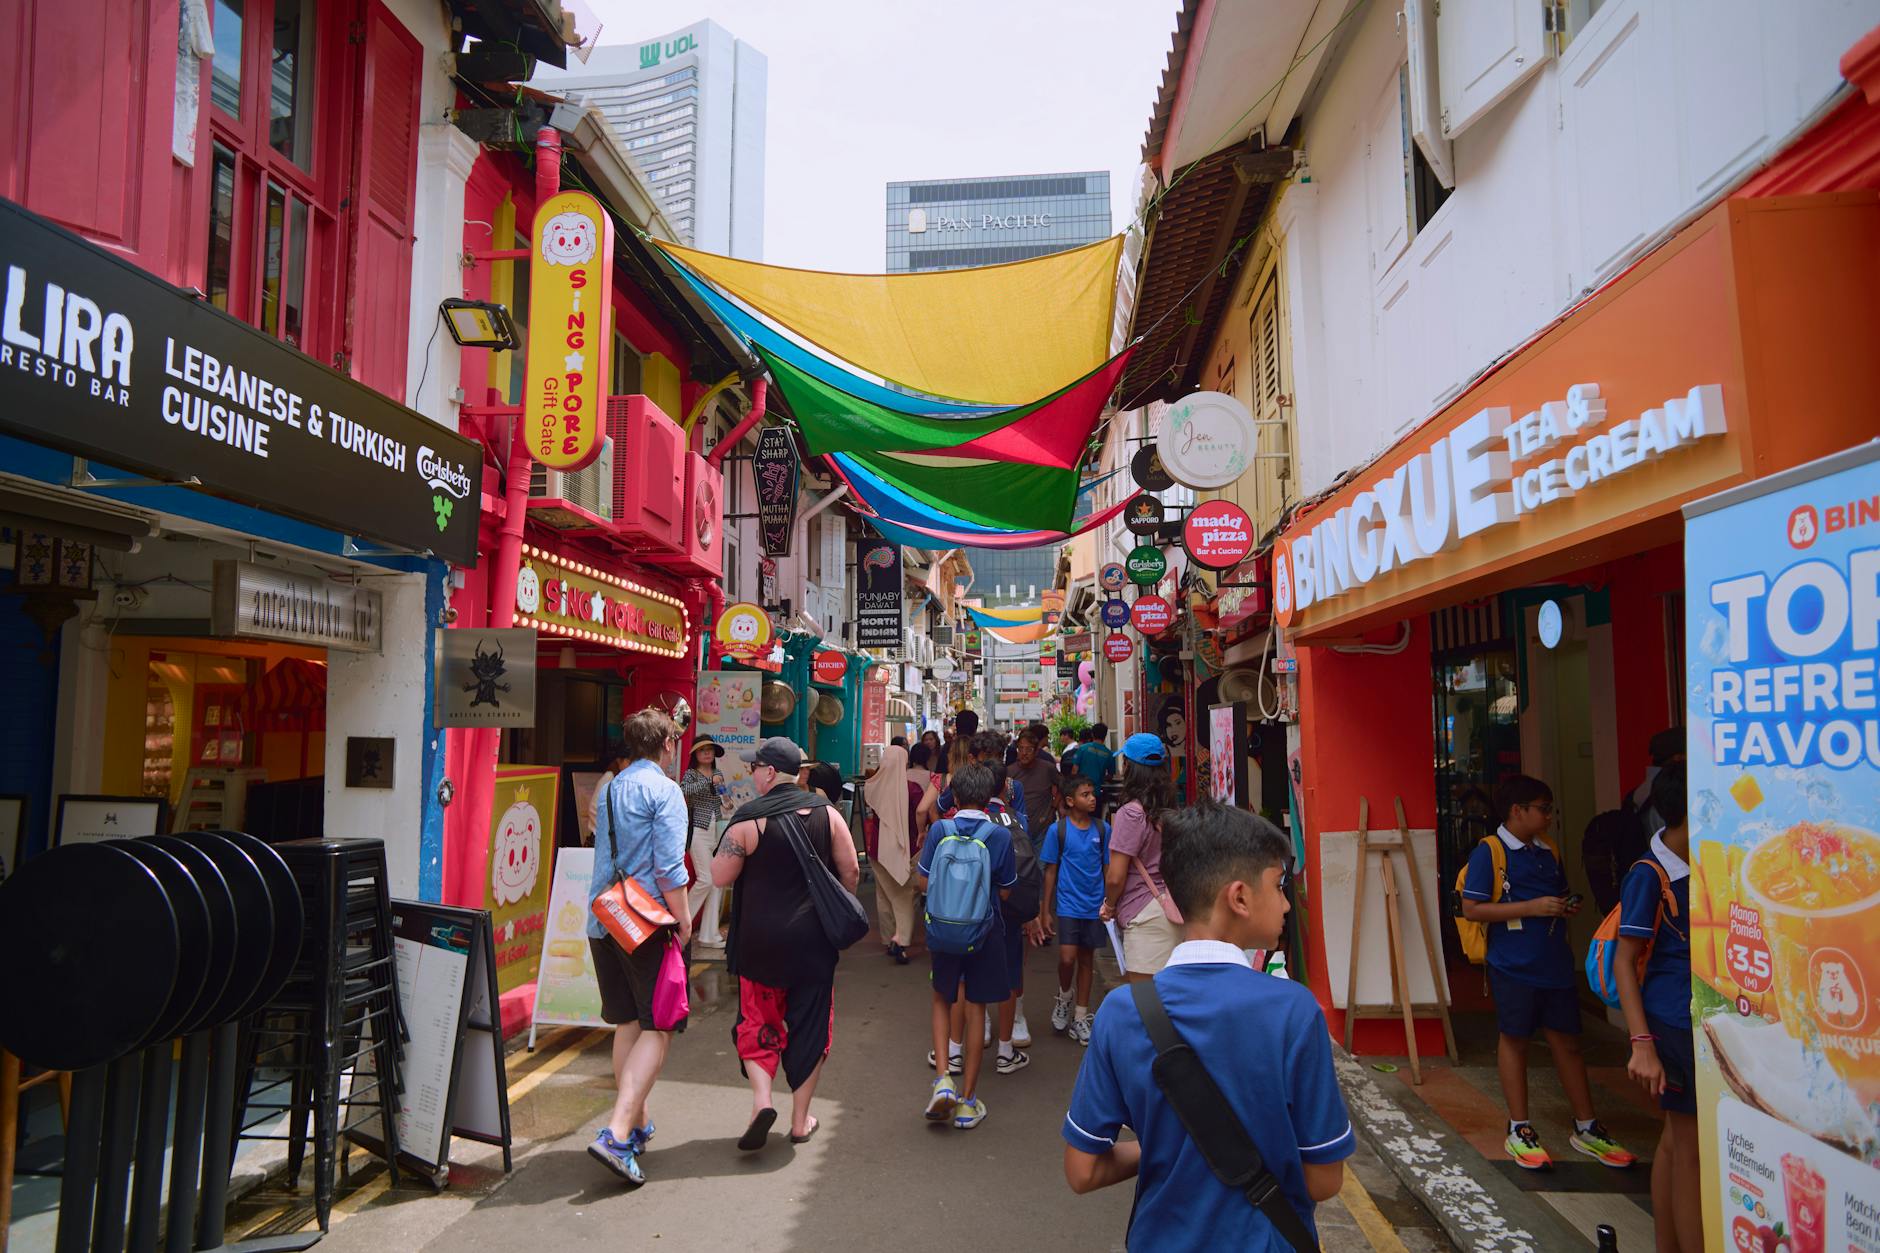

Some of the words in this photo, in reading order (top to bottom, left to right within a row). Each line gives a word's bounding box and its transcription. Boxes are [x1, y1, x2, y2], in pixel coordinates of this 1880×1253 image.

[666, 33, 698, 59] UOL
[936, 216, 972, 232] PAN
[982, 212, 1051, 231] PACIFIC
[3, 265, 134, 387] LIRA
[1, 344, 77, 388] RESTO
[91, 378, 130, 407] BAR
[543, 377, 559, 410] Gift
[165, 337, 302, 428] LEBANESE
[308, 405, 323, 438] &
[329, 412, 406, 473] TURKISH
[162, 386, 270, 458] CUISINE
[1502, 400, 1572, 463] TEA
[1566, 383, 1604, 431] &
[541, 415, 557, 456] Gate
[764, 437, 785, 448] STAY
[1181, 421, 1213, 455] Jen
[761, 448, 789, 460] SHARP
[1198, 443, 1236, 451] BEAUTY
[1512, 460, 1568, 516] ICE
[1565, 384, 1720, 491] CREAM
[416, 445, 471, 497] Carlsberg
[762, 504, 789, 514] MUTHA
[1292, 407, 1514, 611] BINGXUE
[1825, 495, 1880, 534] BIN
[1131, 516, 1159, 524] SAPPORO
[1202, 529, 1248, 547] pizza
[1218, 547, 1242, 555] Cucina
[1129, 558, 1164, 572] Carlsberg
[859, 592, 900, 603] PUNJABY
[864, 601, 895, 609] DAWAT
[861, 617, 898, 626] NORTH
[1140, 612, 1168, 623] pizza
[861, 628, 898, 636] INDIAN
[818, 661, 845, 669] KITCHEN
[711, 734, 756, 744] NGAPORE
[1730, 904, 1758, 925] Mango
[1730, 920, 1762, 940] Pomelo
[1727, 1128, 1754, 1153] Lychee
[1728, 1144, 1775, 1182] Watermelon
[1846, 1211, 1872, 1239] Bean
